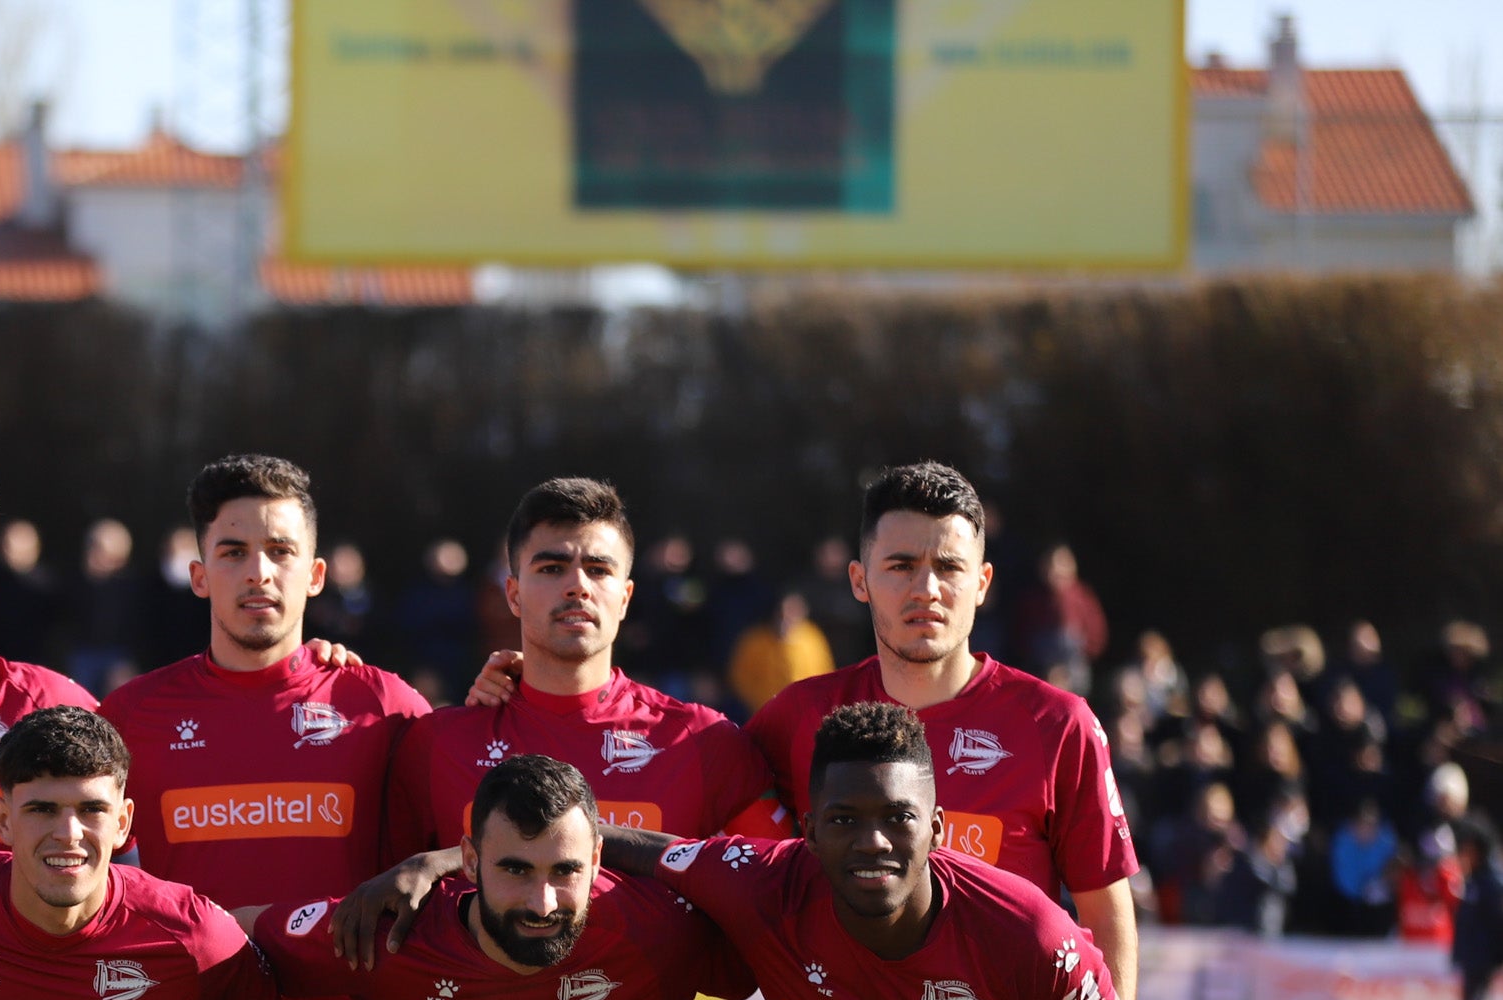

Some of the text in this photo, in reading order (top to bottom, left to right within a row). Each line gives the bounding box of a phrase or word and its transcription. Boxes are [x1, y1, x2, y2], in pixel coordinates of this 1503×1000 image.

[169, 740, 206, 750] KELME
[173, 793, 312, 829] euskaltel
[291, 907, 316, 930] 2B
